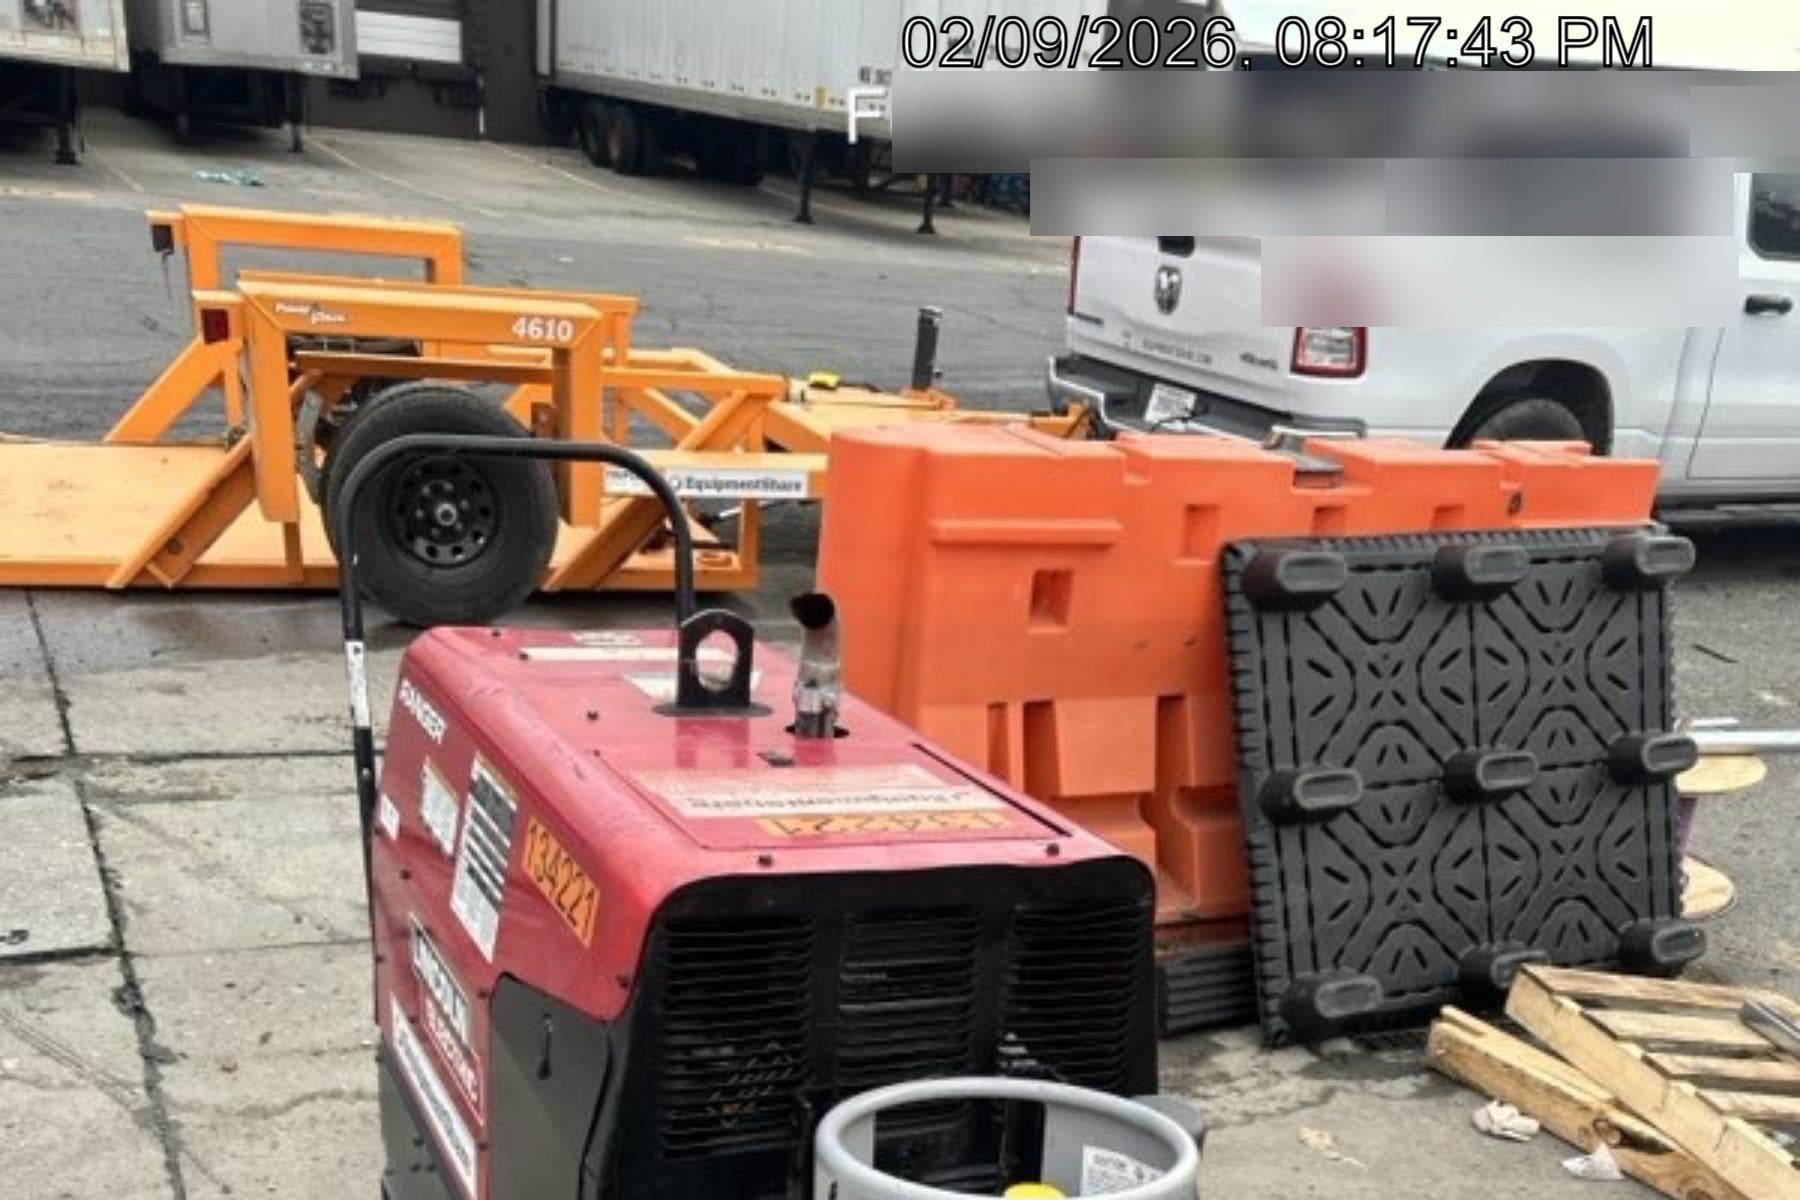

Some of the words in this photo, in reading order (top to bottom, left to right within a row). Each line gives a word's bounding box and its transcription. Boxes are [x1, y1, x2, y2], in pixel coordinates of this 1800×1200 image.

[512, 316, 574, 341] 4610
[686, 477, 802, 492] EquipmentShare
[525, 821, 597, 943] 134221
